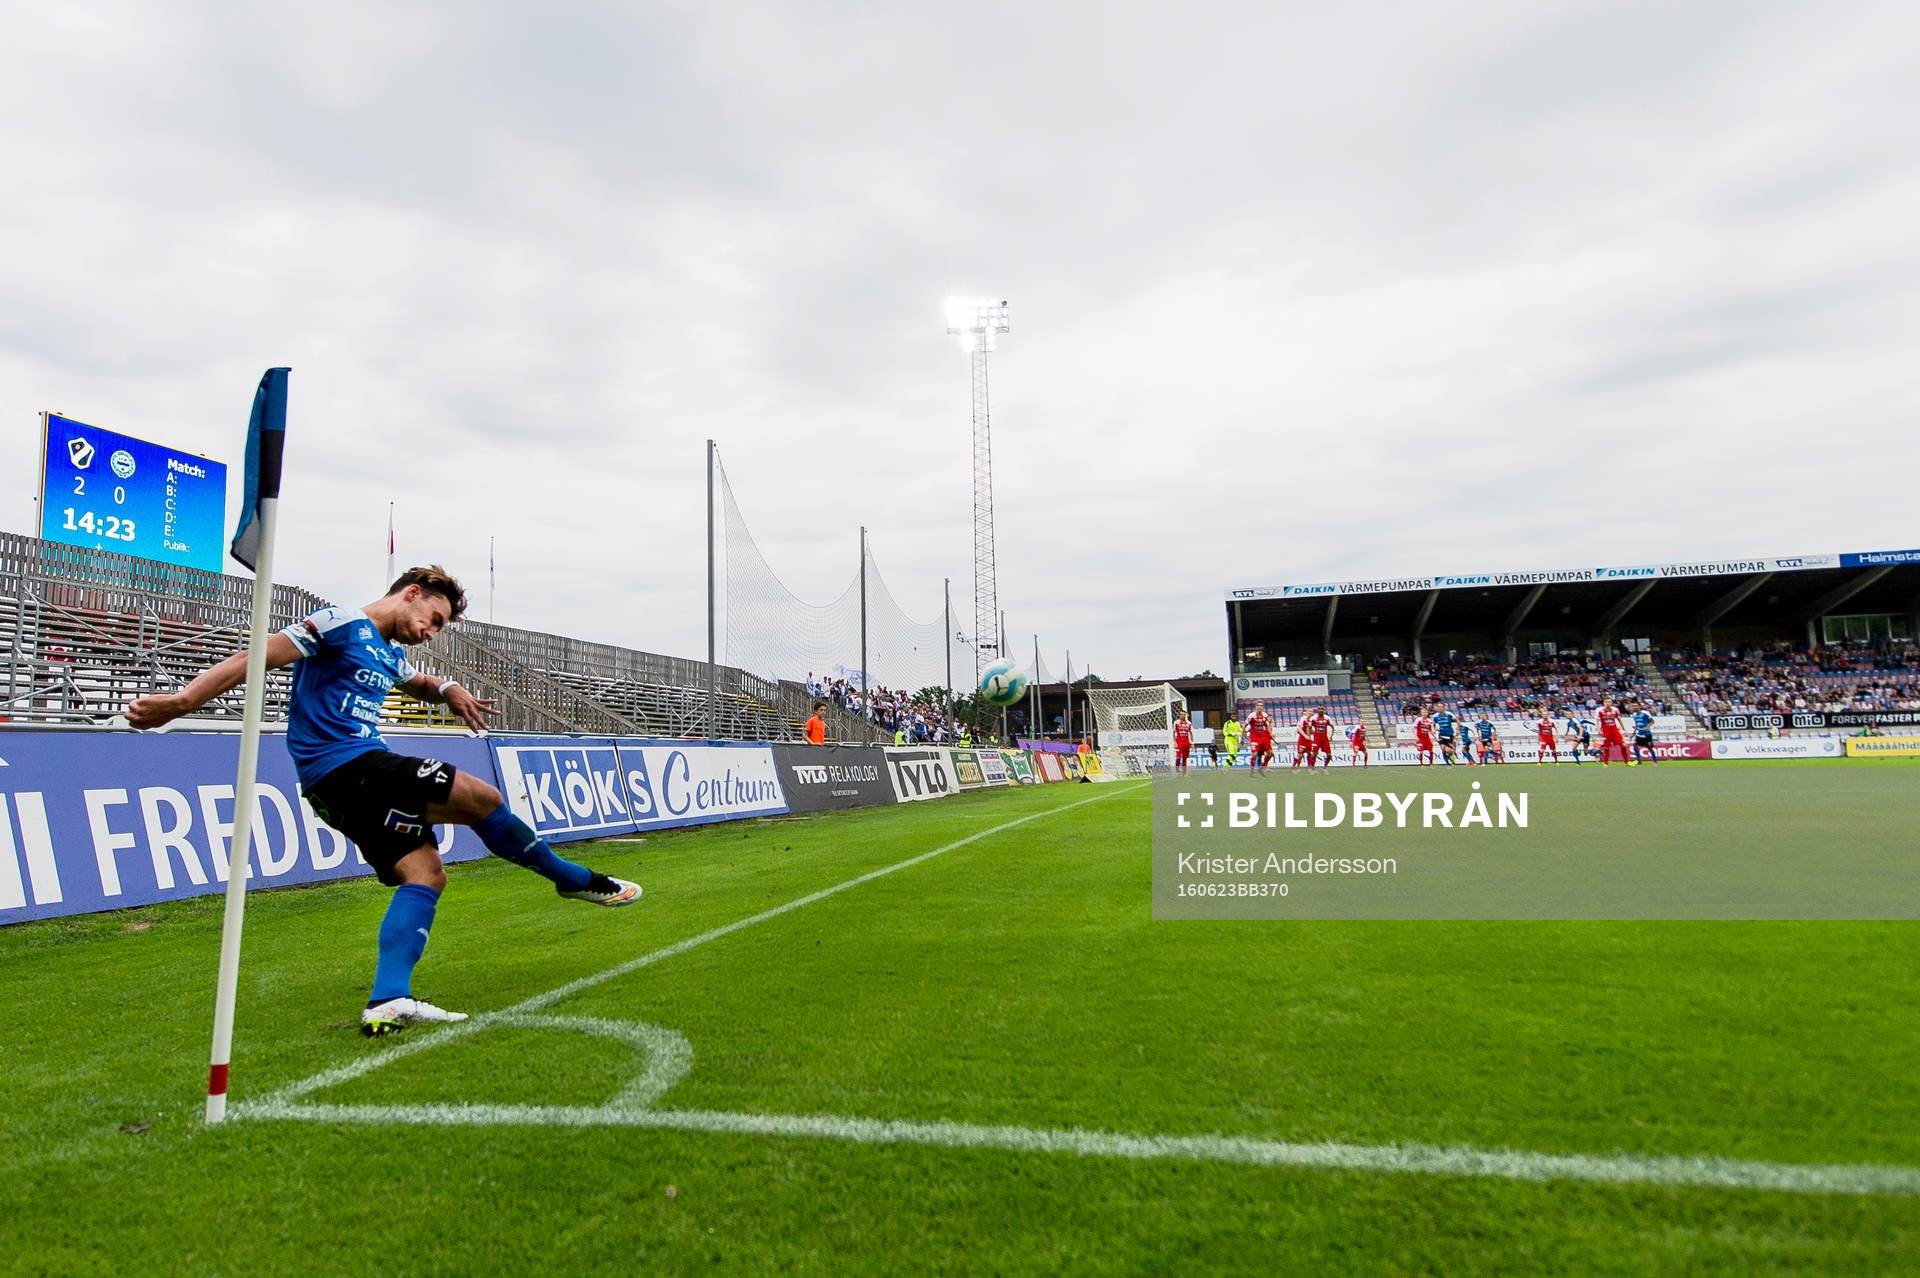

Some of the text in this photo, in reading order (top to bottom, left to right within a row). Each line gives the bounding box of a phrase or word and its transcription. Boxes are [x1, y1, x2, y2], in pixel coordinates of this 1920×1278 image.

[167, 458, 206, 478] Match:
[74, 476, 86, 496] 2
[166, 472, 178, 485] A:
[114, 486, 125, 504] 0
[166, 485, 177, 497] B:
[165, 498, 176, 511] C:
[63, 507, 136, 542] 14:23
[165, 512, 177, 524] D:
[164, 525, 175, 537] E:
[163, 540, 190, 553] Publik:
[1608, 560, 1766, 577] DAIKIN VÄRMEPUMPAR
[1446, 570, 1593, 586] DAIKIN VÄRMEPUMPAR
[1294, 579, 1432, 595] DAIKIN VÄRMEPUMPAR
[1252, 677, 1325, 689] MOTORHALLAND
[1831, 715, 1875, 724] FOREVER
[1876, 714, 1912, 722] FASTER
[1744, 744, 1807, 754] Volkswagen
[435, 770, 448, 783] 17
[829, 765, 879, 782] RELAXOLOGY
[886, 752, 947, 798] TYLÖ
[525, 751, 777, 823] KÖKS Centrum
[84, 780, 455, 897] FREDB
